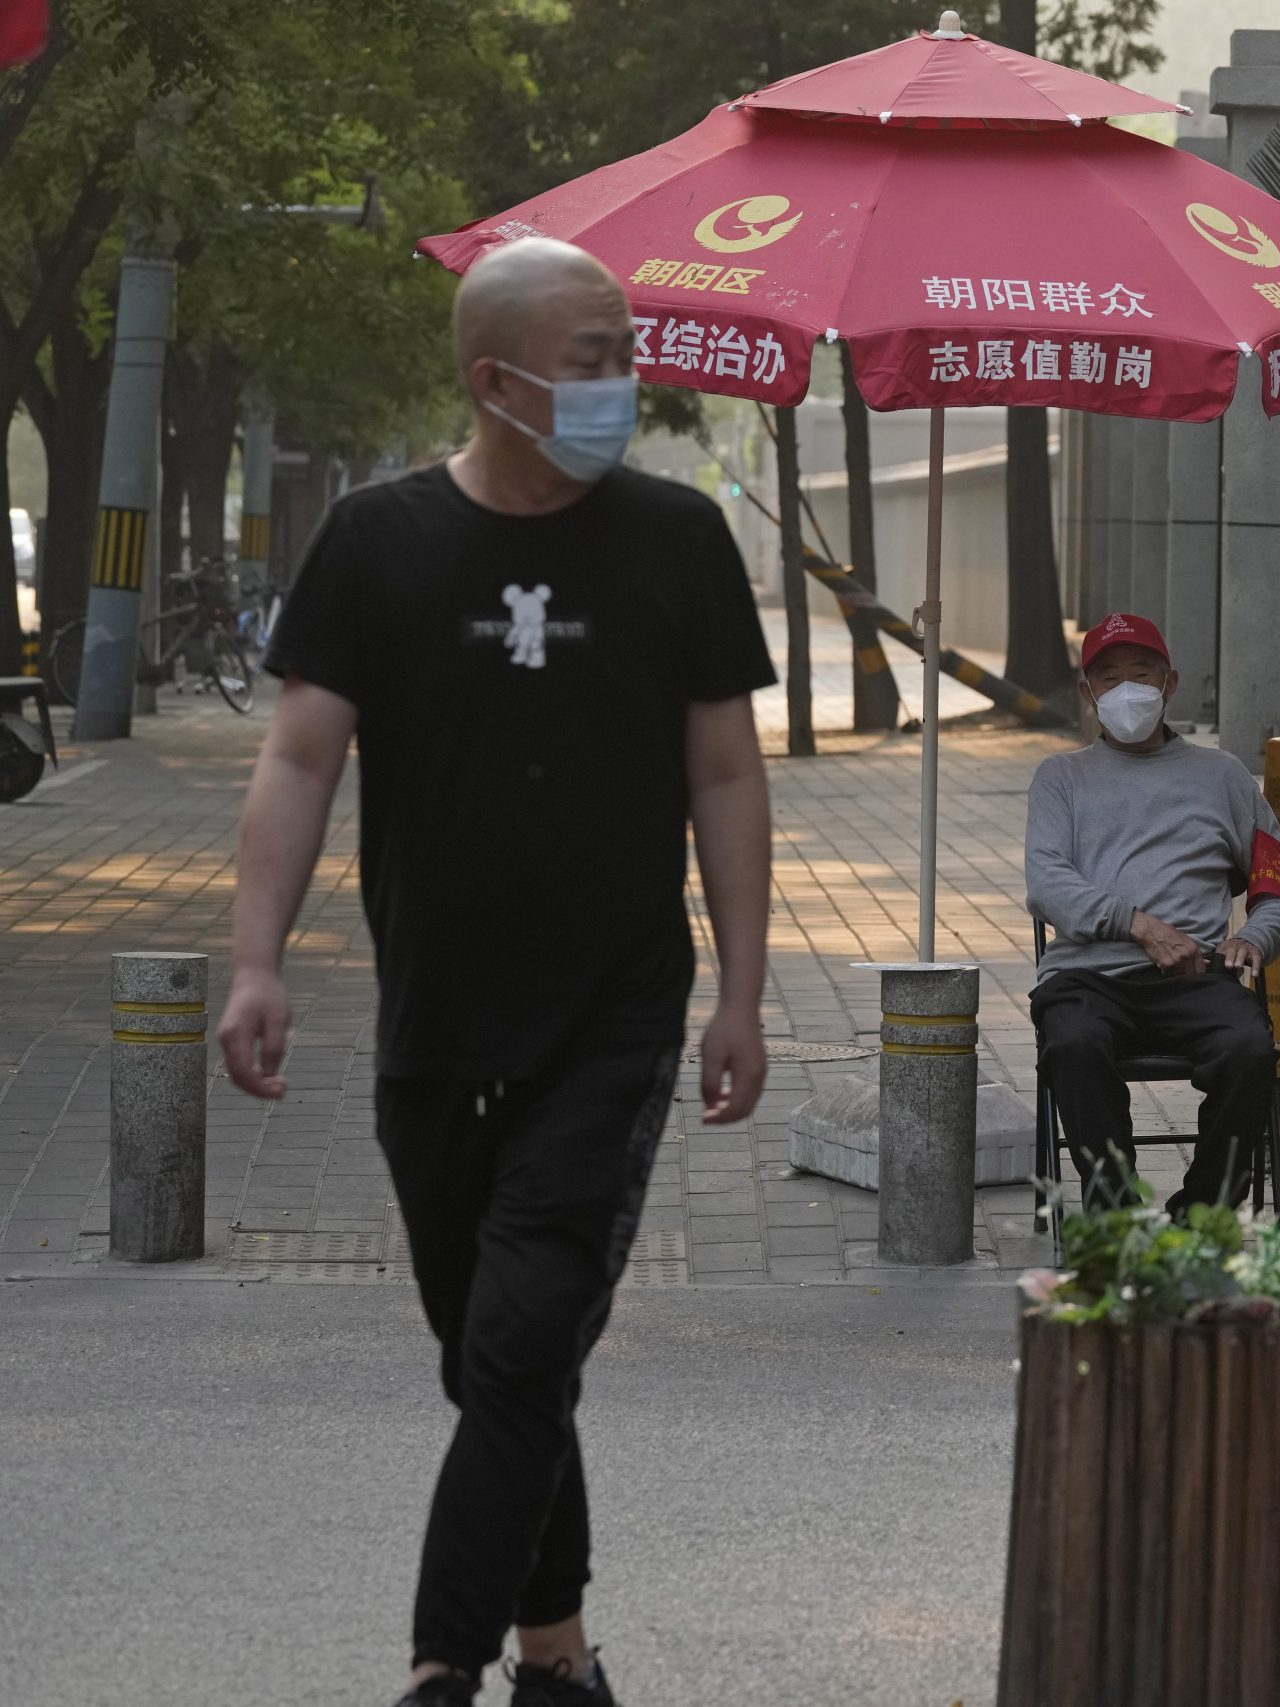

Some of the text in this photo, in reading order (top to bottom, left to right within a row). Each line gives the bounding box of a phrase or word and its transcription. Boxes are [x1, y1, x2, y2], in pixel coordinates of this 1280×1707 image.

[629, 258, 767, 295] 朝阳区
[922, 276, 1154, 318] 朝阳群众
[632, 316, 785, 385] 区综治办
[929, 339, 1153, 389] 志愿值勤岗
